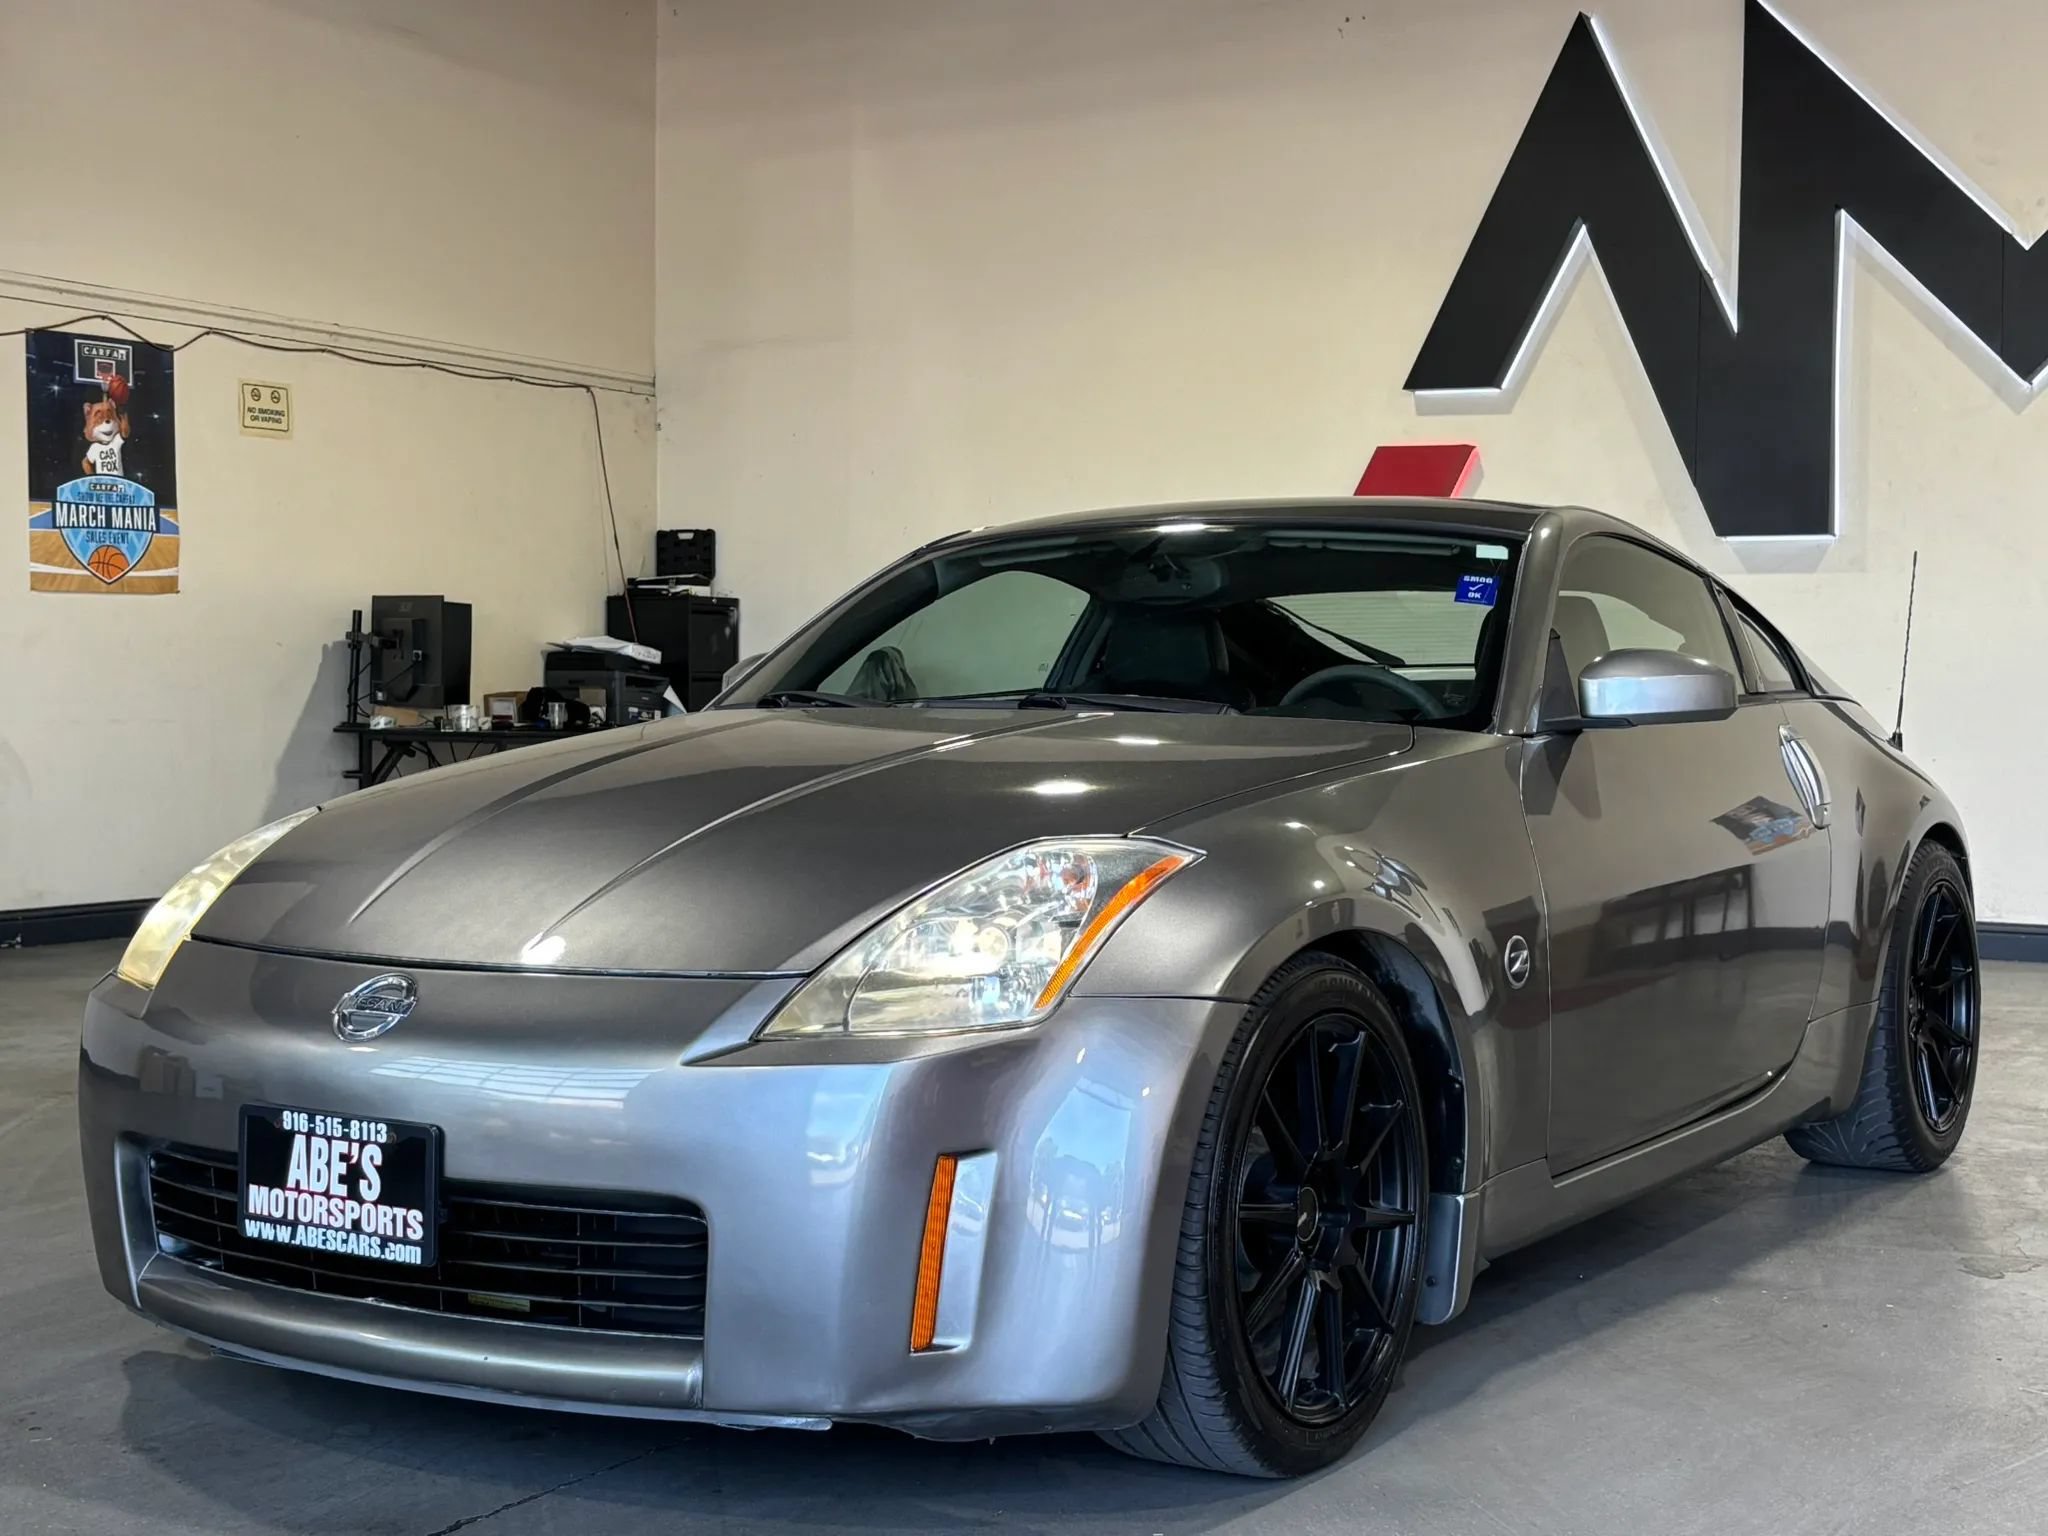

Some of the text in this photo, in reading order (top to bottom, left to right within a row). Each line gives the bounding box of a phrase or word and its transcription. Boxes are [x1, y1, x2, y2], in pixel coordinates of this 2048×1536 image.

[250, 414, 282, 424] OR VAPING
[258, 408, 285, 417] SMOKING
[99, 447, 117, 461] CAR
[101, 460, 119, 472] FOX
[56, 502, 157, 531] MARCH MANIA
[86, 530, 129, 545] SALES EVENT
[1463, 575, 1493, 584] SMOG
[1467, 591, 1482, 599] OK
[282, 1110, 388, 1143] 916-515-8113
[286, 1133, 383, 1202] ABE'S
[248, 1183, 424, 1241] MOTORSPORTS
